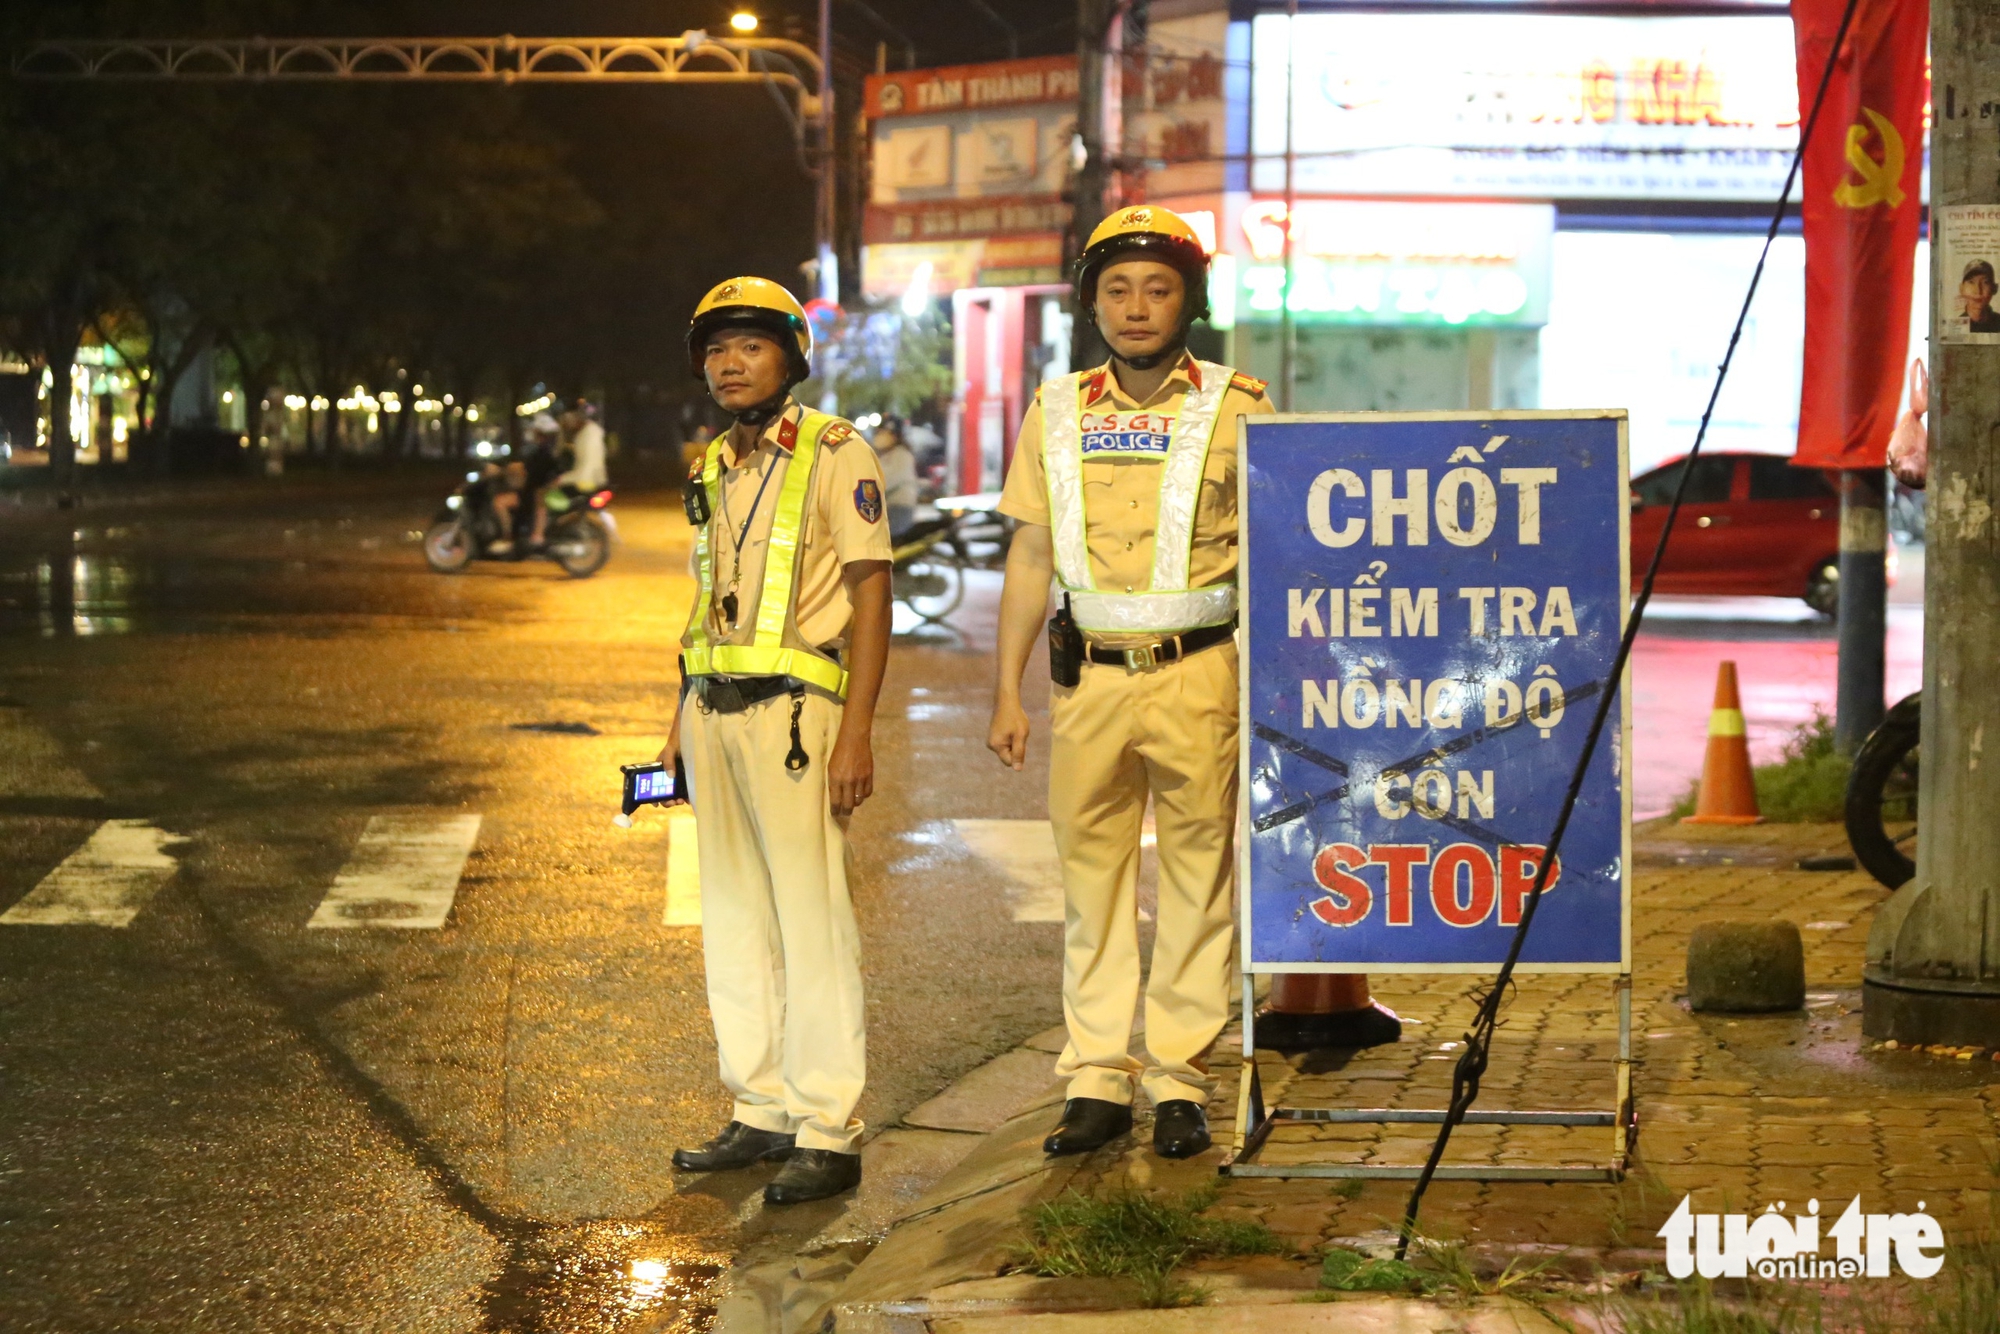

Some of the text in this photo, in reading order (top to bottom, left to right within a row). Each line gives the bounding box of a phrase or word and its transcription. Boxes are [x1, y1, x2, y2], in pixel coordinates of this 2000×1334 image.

[1086, 434, 1164, 450] POLICE
[1307, 436, 1558, 548] CHỐT
[1288, 560, 1579, 638] KIỂM TRA
[1302, 657, 1566, 738] NỒNG ĐỘ
[1374, 748, 1495, 820] CỒN
[1308, 842, 1562, 928] STOP
